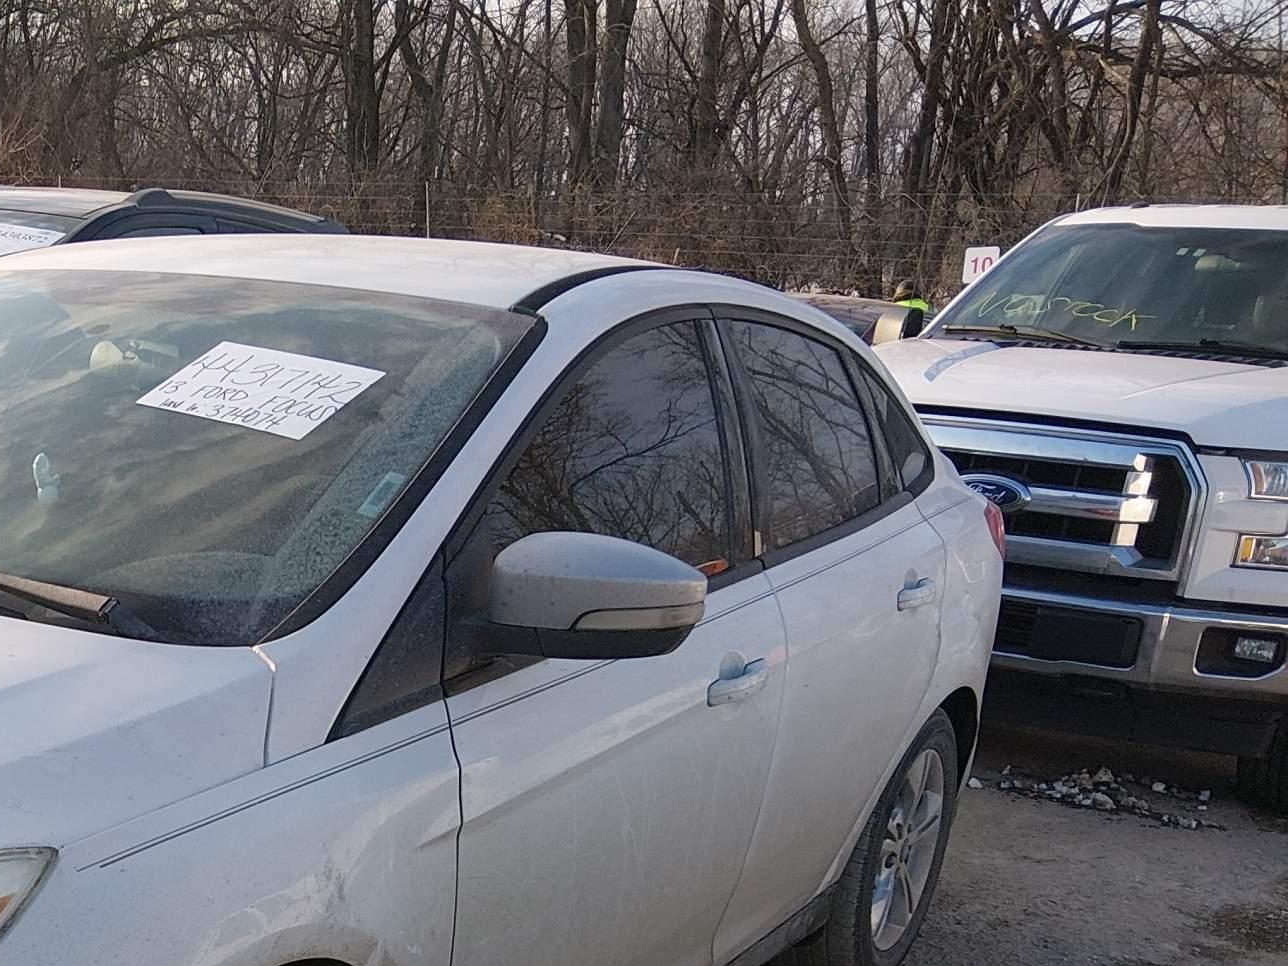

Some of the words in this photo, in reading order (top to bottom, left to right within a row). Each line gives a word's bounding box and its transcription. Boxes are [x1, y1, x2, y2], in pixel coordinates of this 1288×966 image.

[970, 256, 993, 274] 10
[192, 353, 362, 404] 44317142
[159, 380, 187, 394] 13
[190, 385, 249, 401] FORD
[258, 395, 339, 421] FOCUS
[205, 404, 287, 430] 374074
